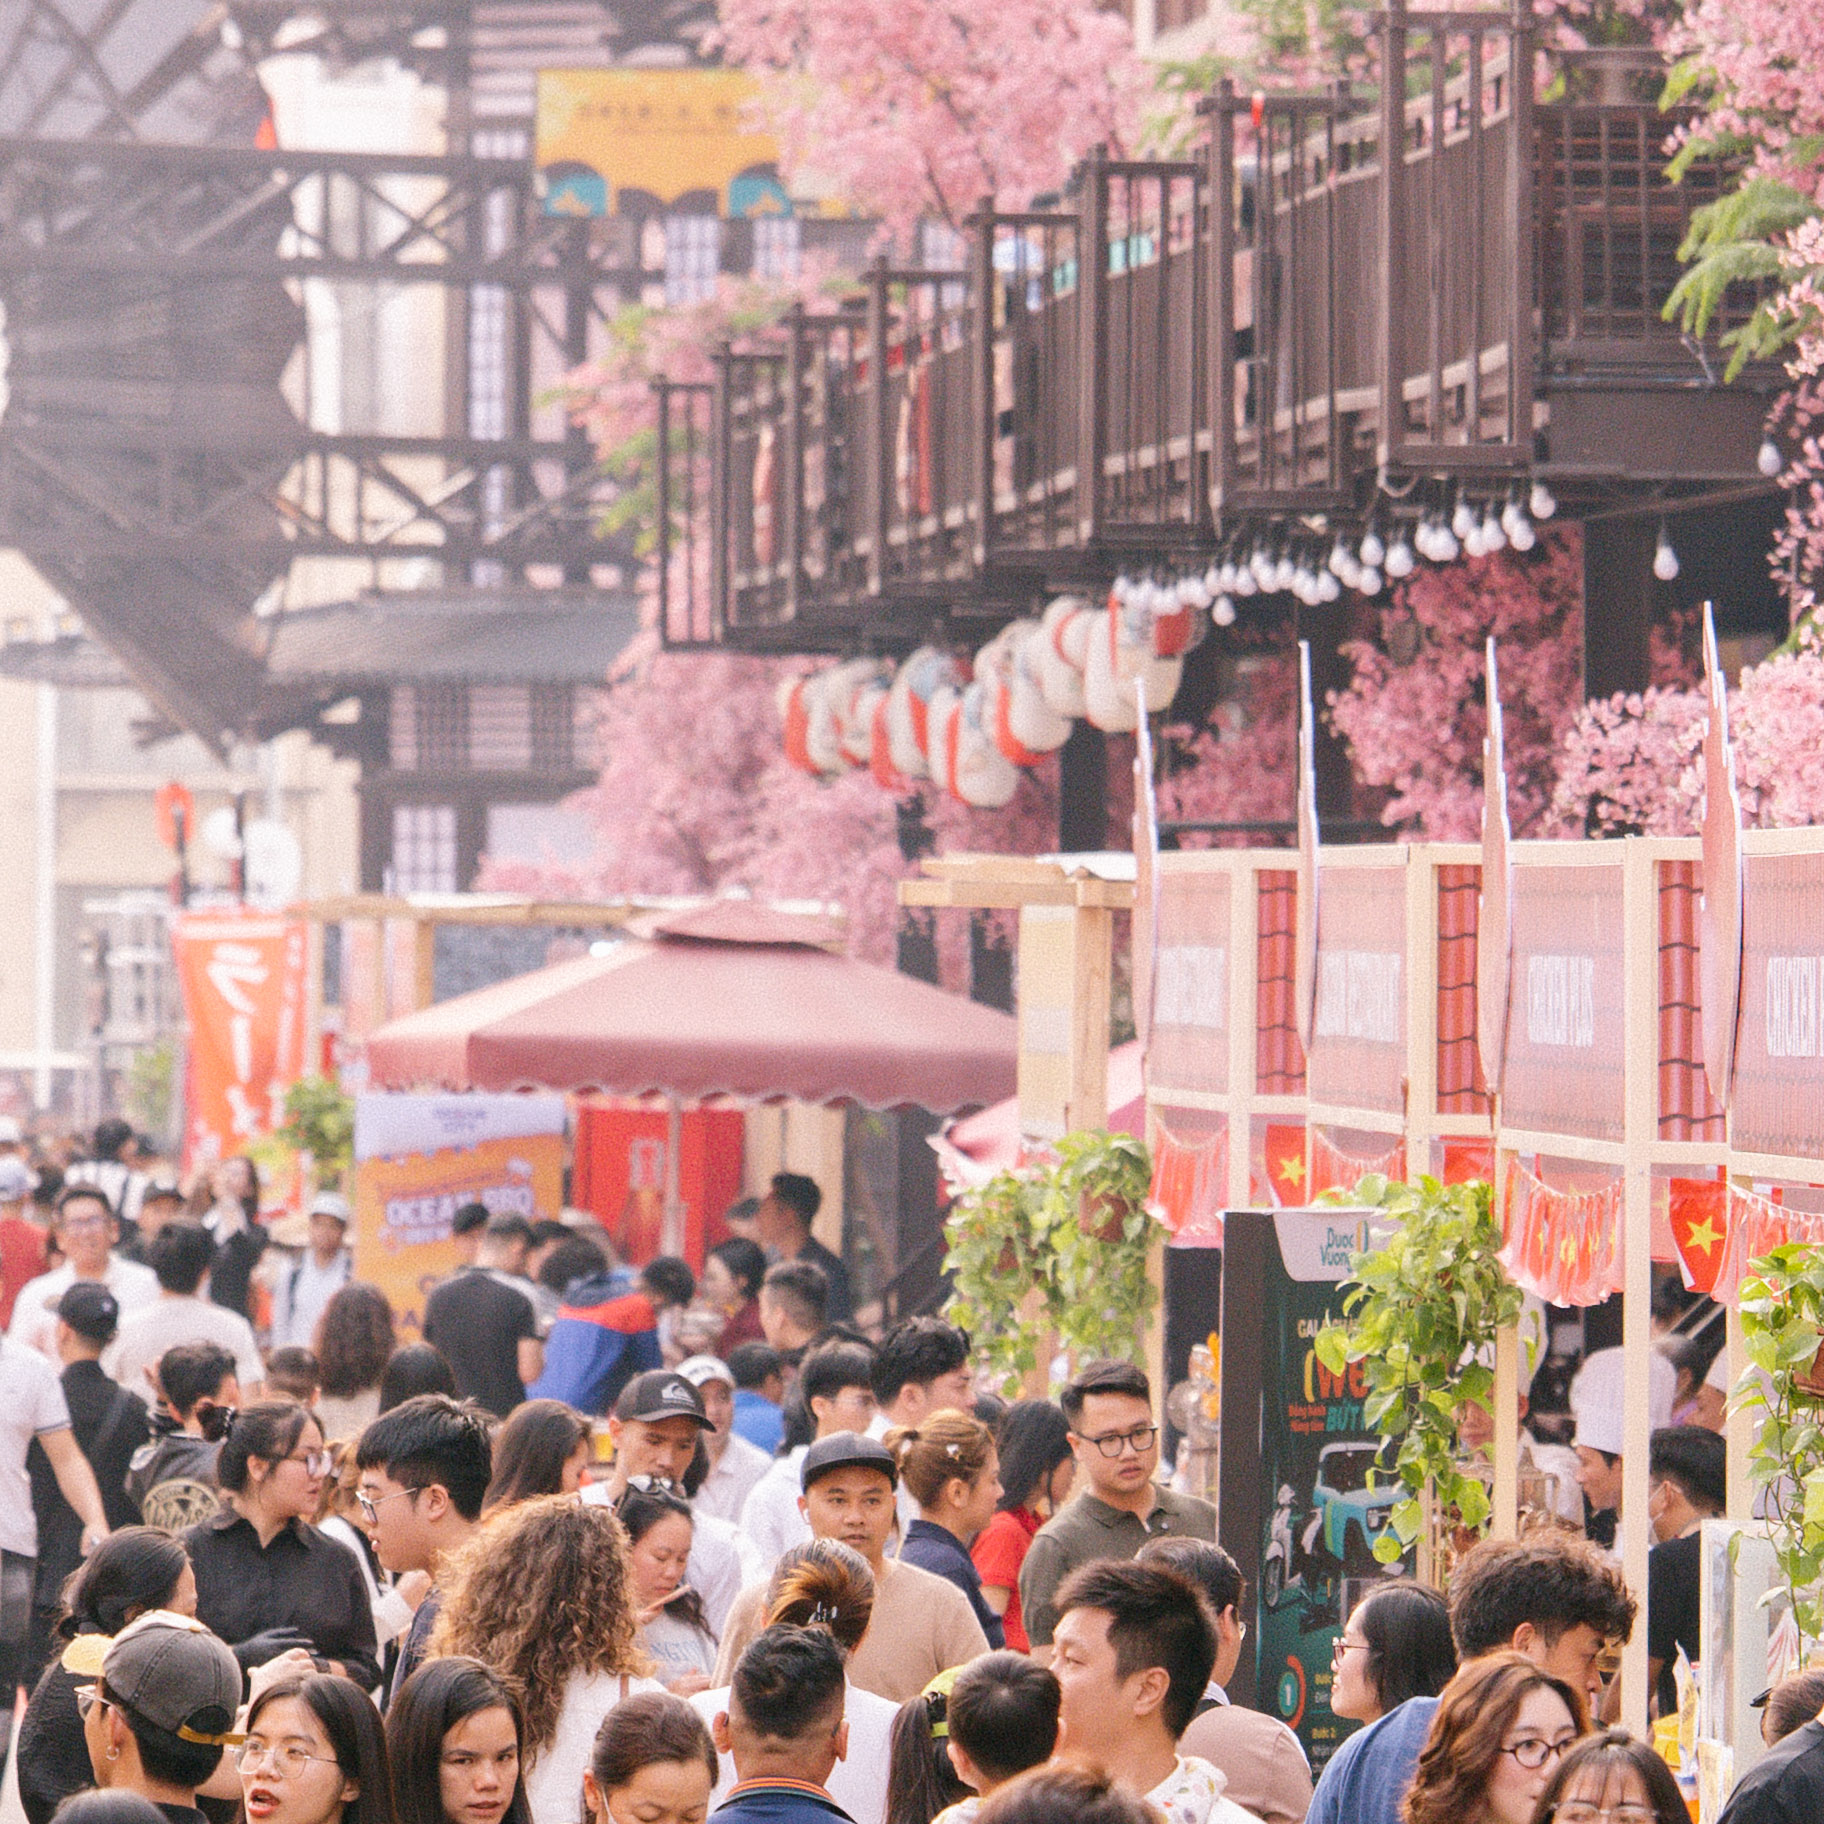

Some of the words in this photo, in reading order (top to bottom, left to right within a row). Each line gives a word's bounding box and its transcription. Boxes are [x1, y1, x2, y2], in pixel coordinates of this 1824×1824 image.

[205, 942, 269, 1138] ラーメ
[1767, 956, 1817, 1057] CHICKEN
[1285, 1684, 1292, 1706] 1
